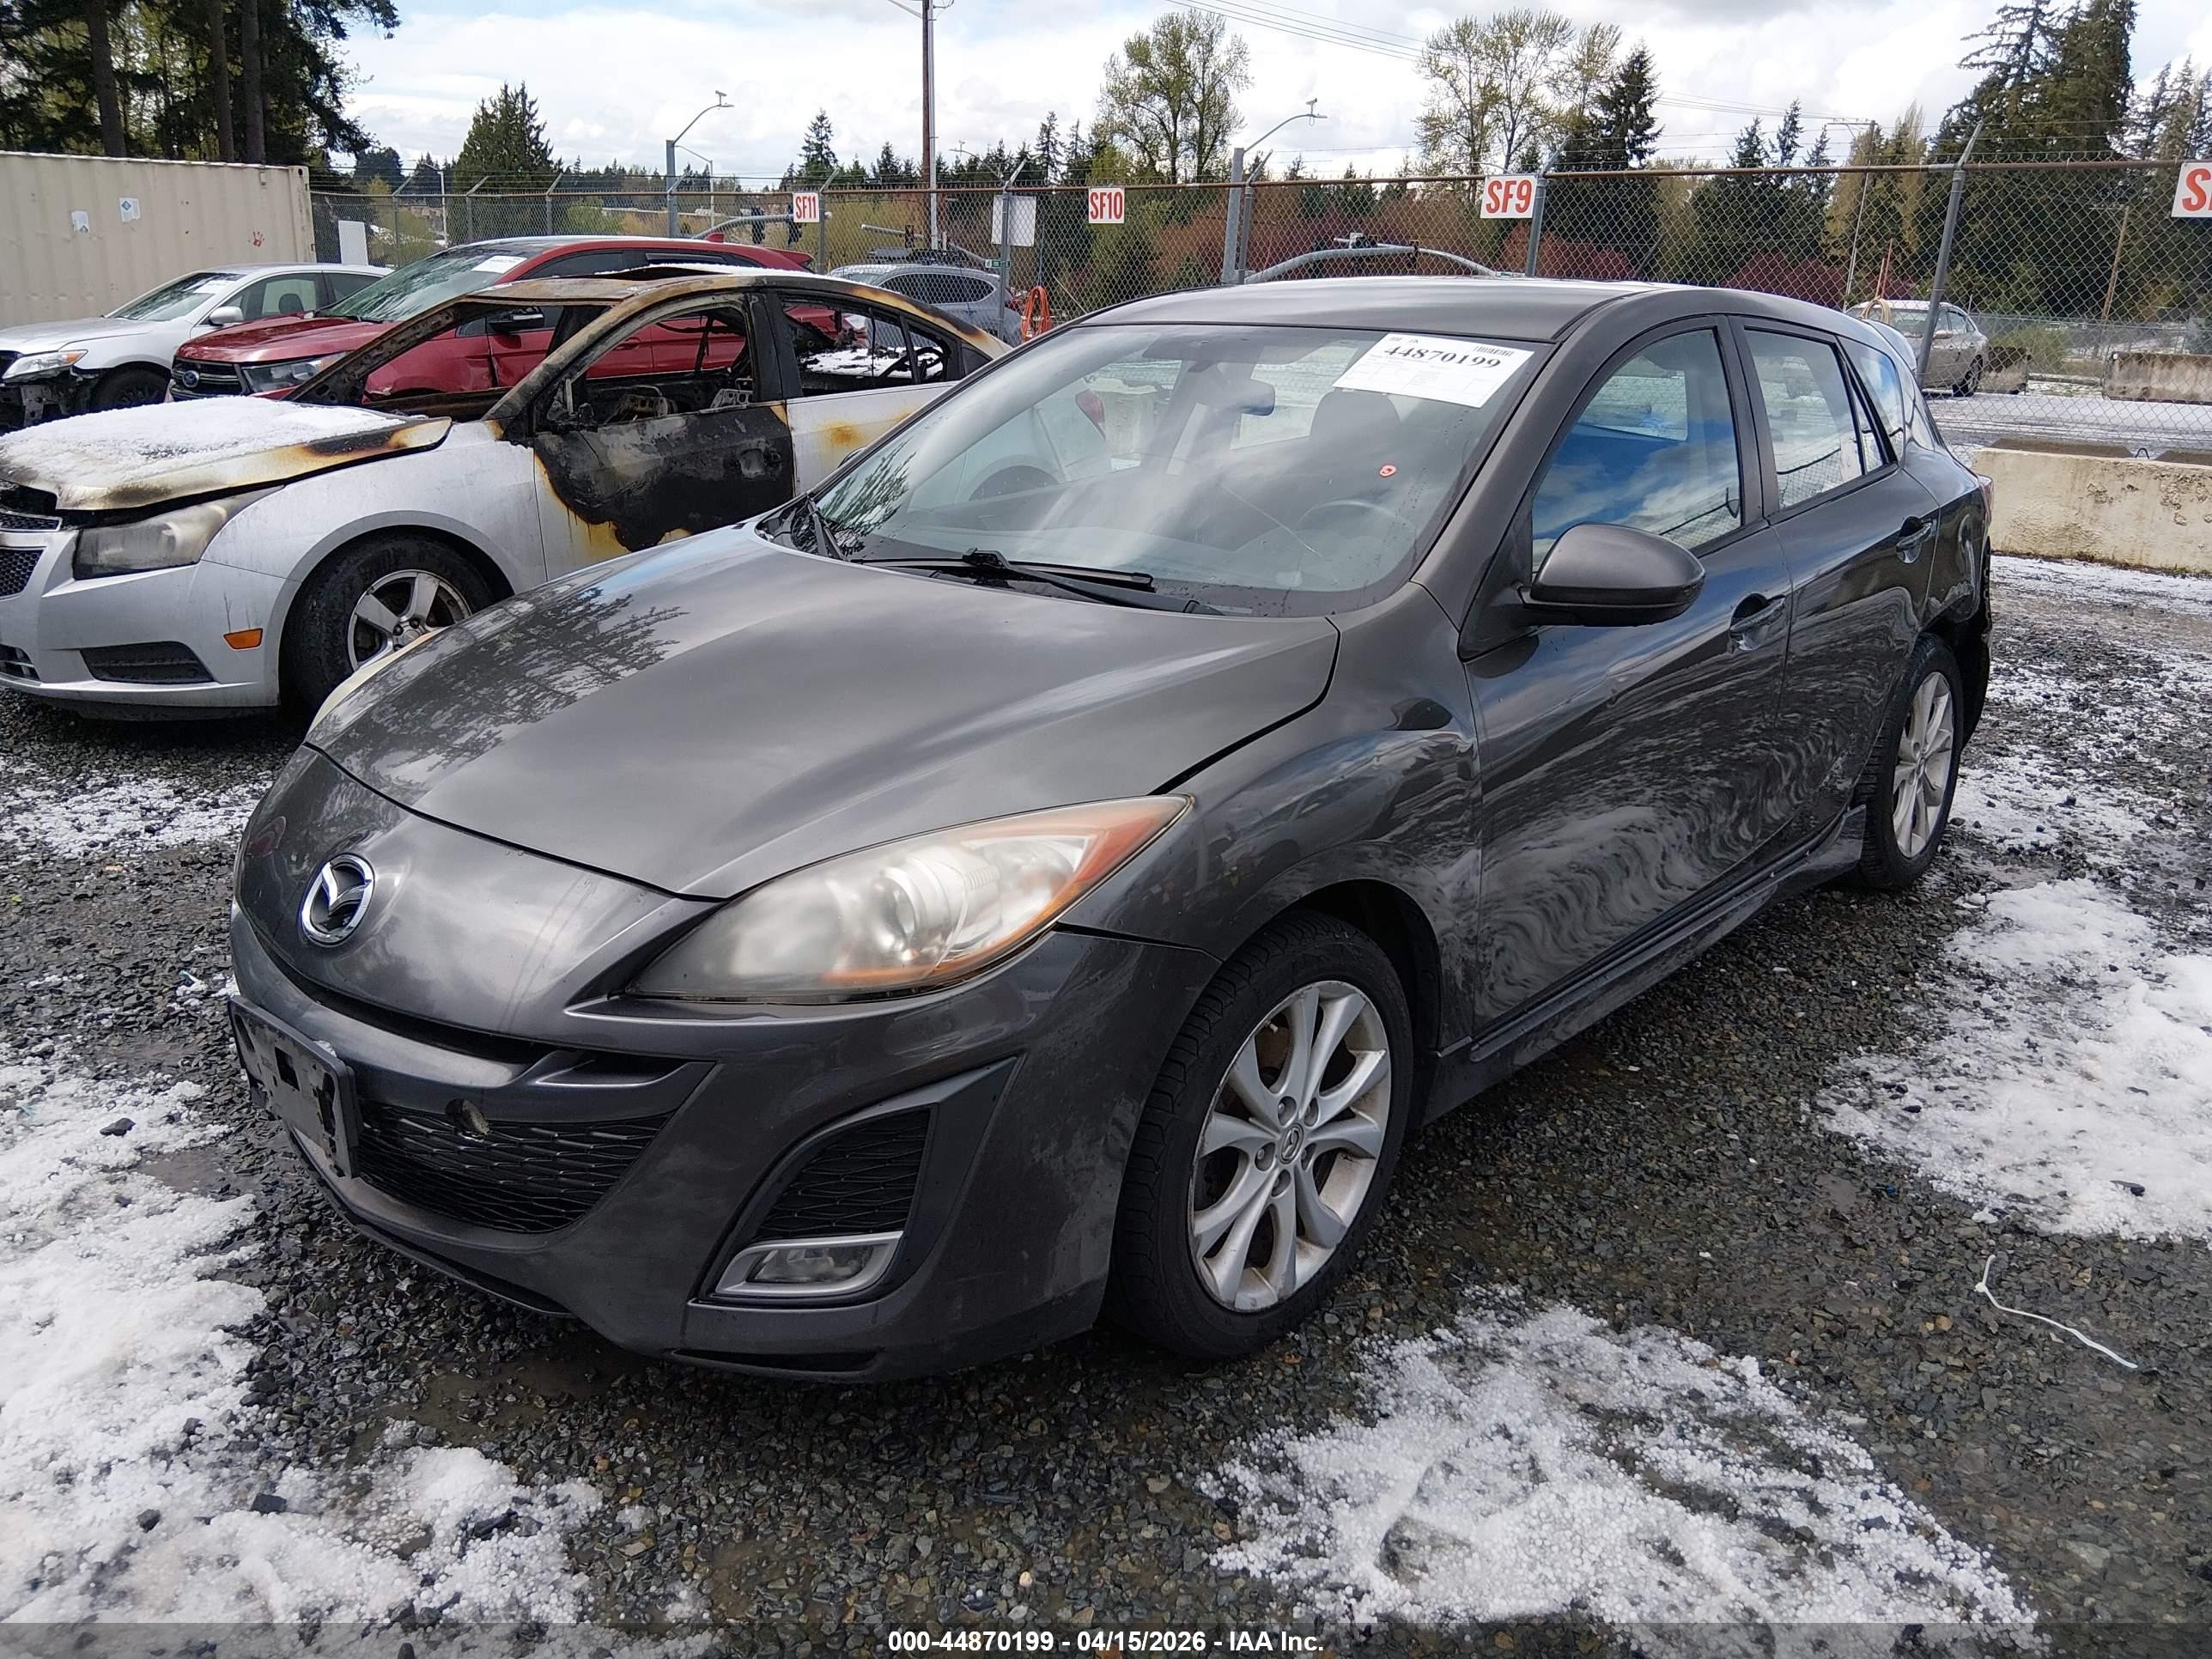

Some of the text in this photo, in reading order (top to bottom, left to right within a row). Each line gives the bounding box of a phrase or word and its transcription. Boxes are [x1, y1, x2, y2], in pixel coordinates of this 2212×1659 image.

[1090, 190, 1123, 220] SF10
[1486, 179, 1532, 214] SF9
[2182, 168, 2212, 212] S
[795, 196, 817, 220] SF11
[1384, 345, 1501, 368] 44870199
